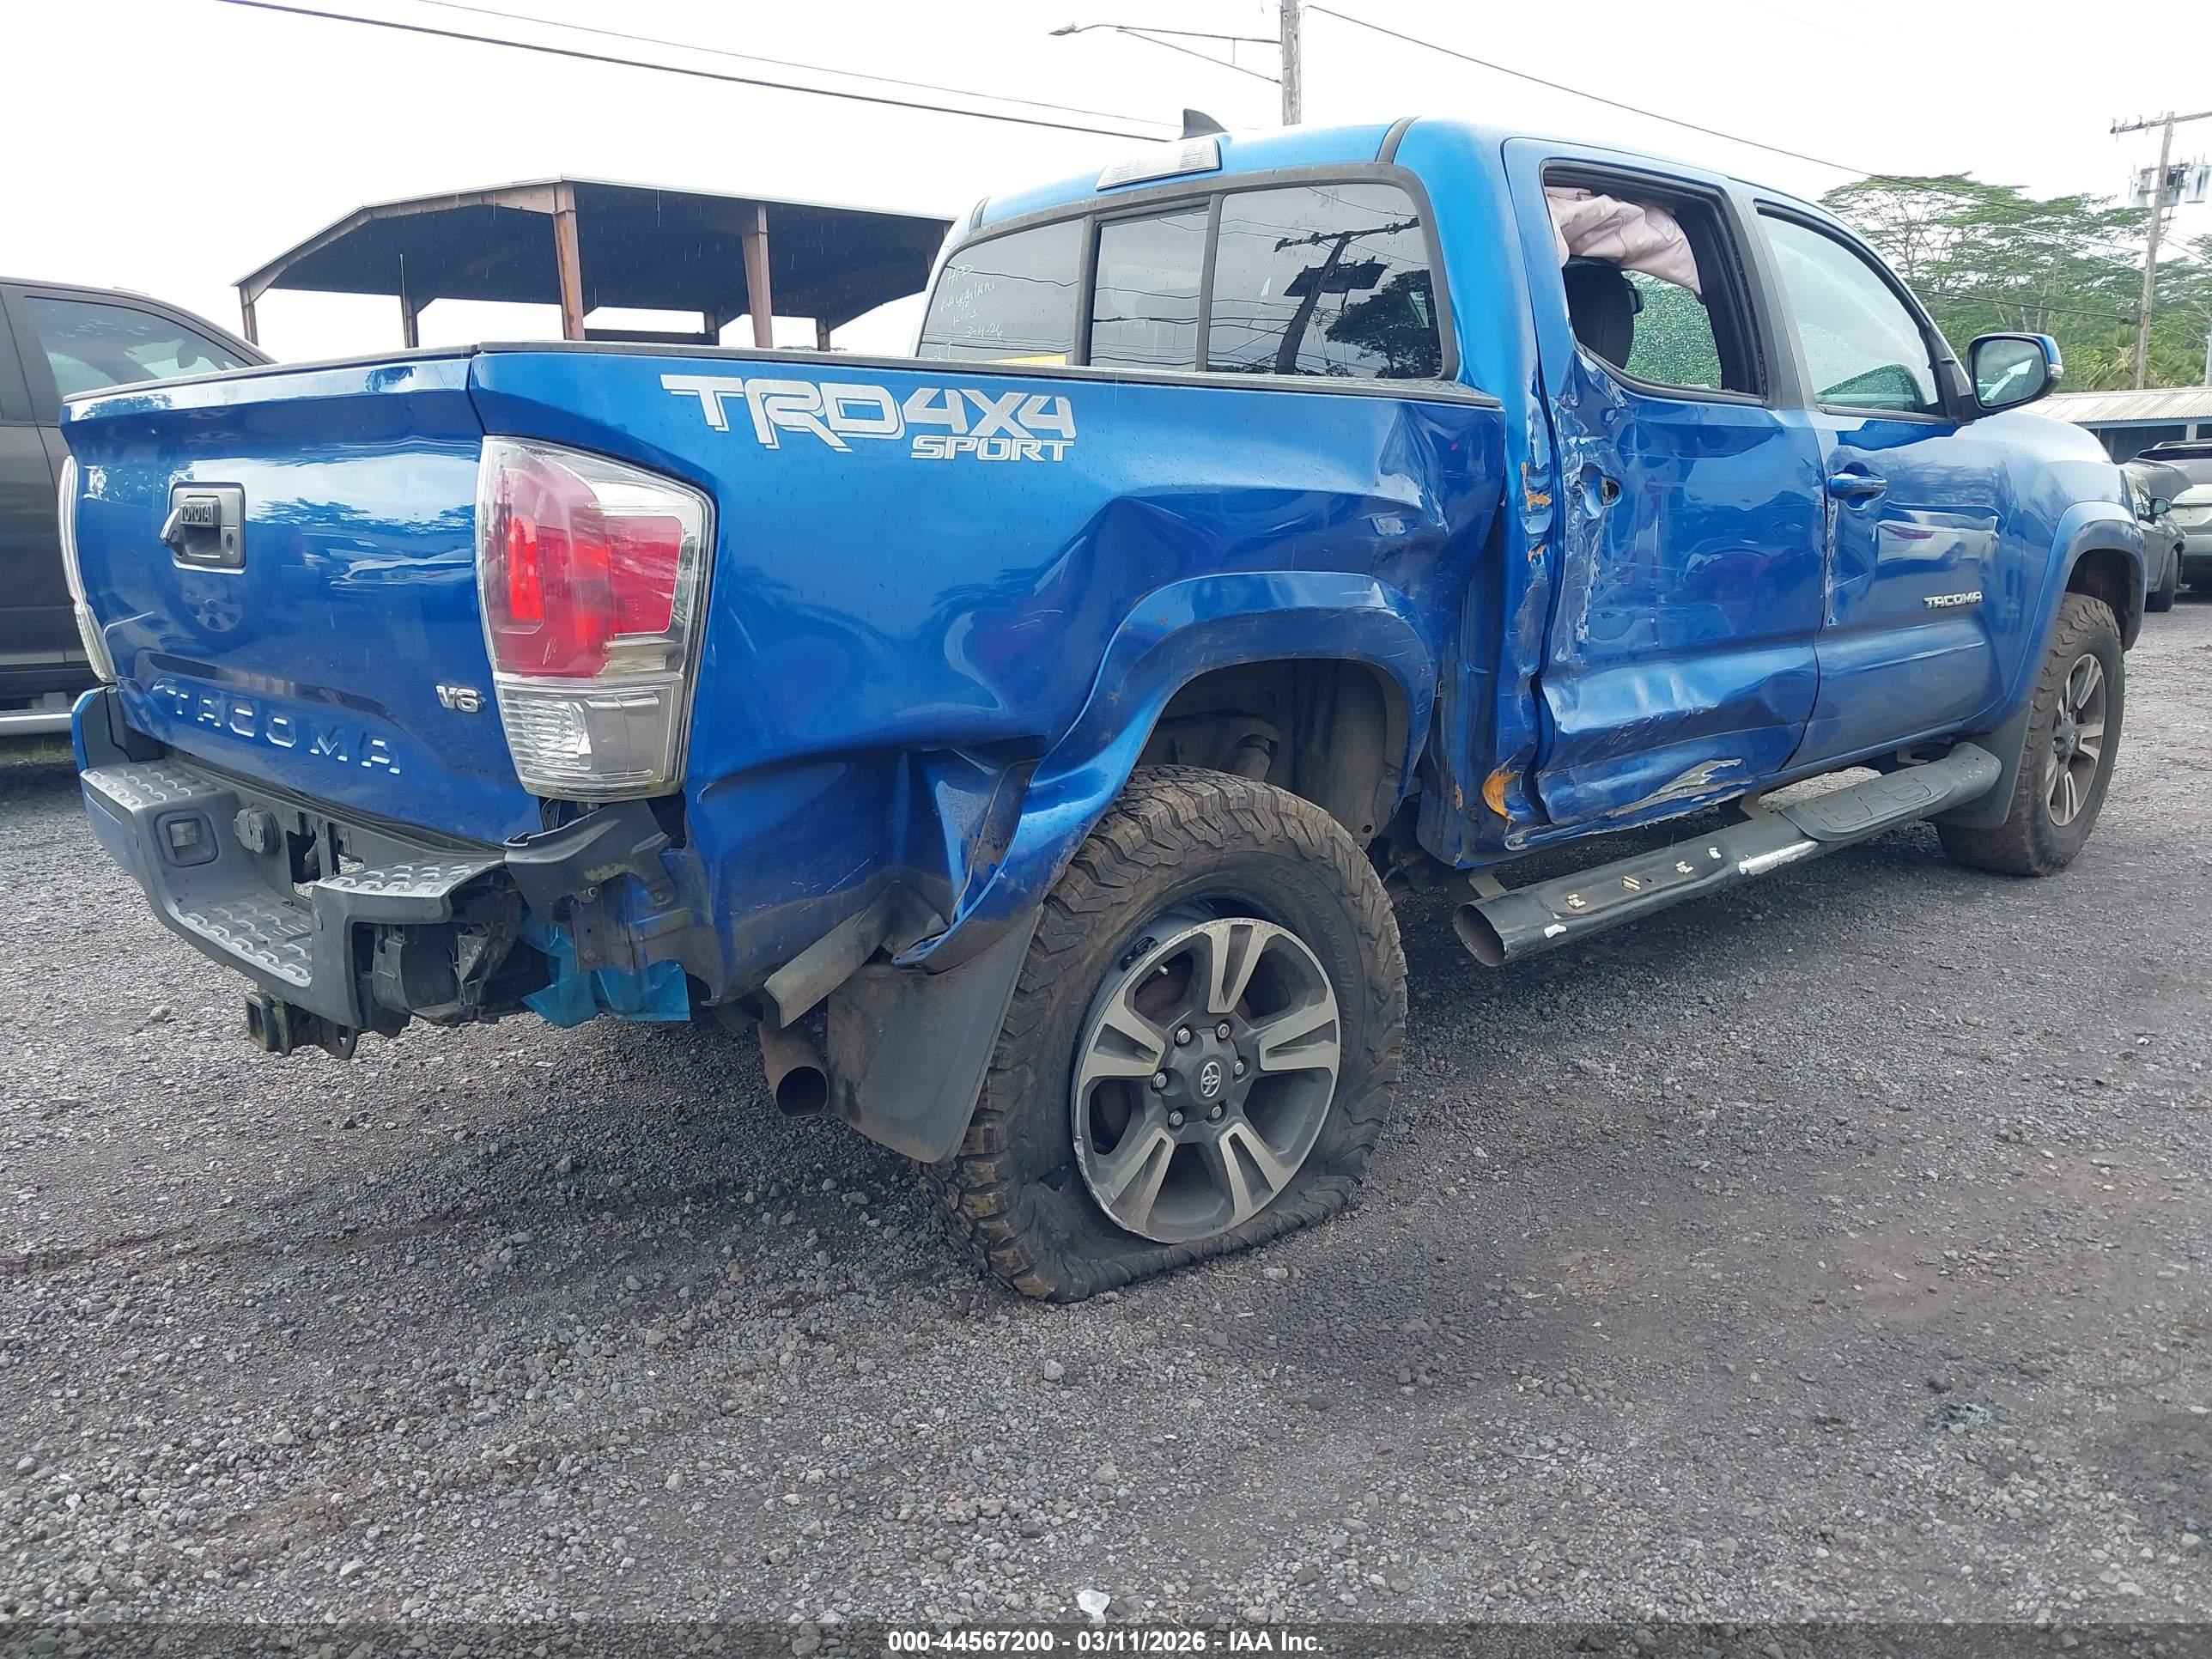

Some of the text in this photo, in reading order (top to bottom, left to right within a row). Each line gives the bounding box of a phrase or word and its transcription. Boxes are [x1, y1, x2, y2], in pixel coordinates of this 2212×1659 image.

[659, 374, 905, 453] TRD
[910, 435, 1075, 461] SPORT
[179, 504, 212, 523] TOYOTA
[1923, 591, 1984, 609] TACOMA
[435, 684, 480, 713] V6
[164, 684, 401, 775] TACOMA
